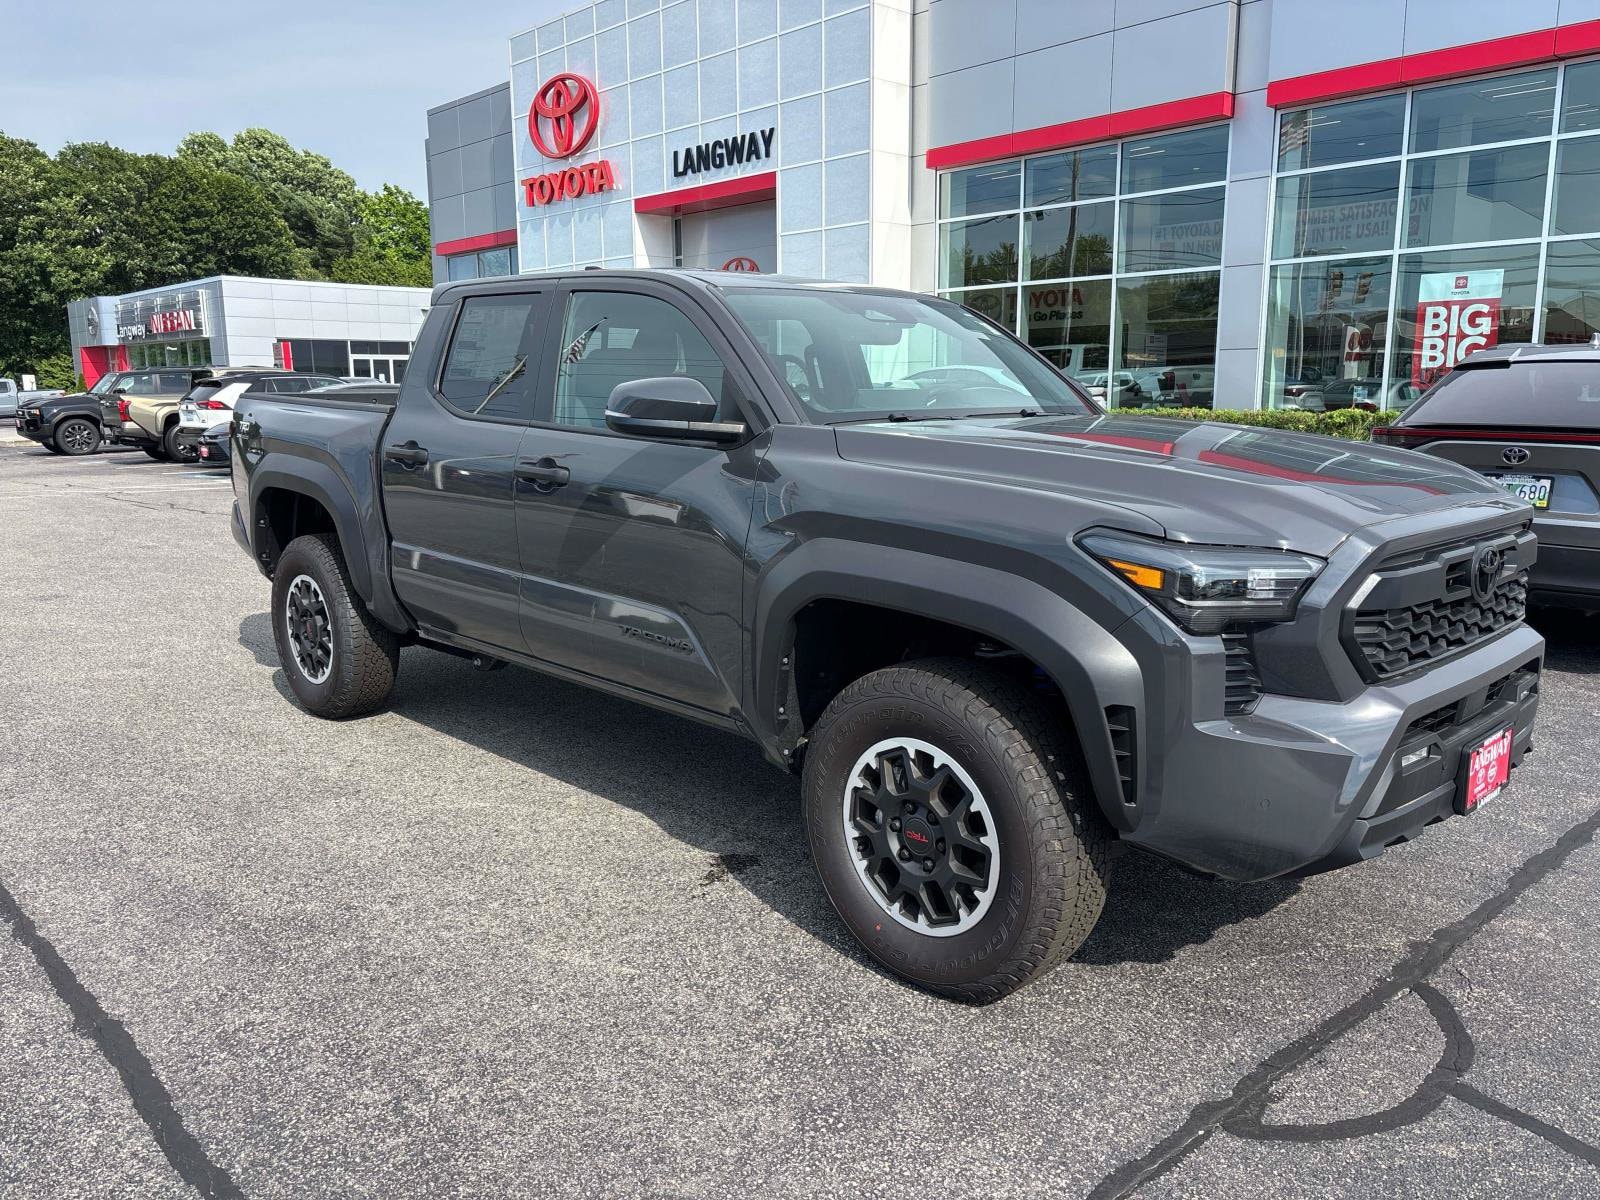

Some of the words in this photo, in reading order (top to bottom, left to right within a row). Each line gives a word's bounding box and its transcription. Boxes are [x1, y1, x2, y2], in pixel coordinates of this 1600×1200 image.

[673, 127, 775, 178] LANGWAY
[521, 160, 616, 207] TOYOTA
[1170, 222, 1210, 240] TOYOTA
[1311, 228, 1325, 243] IN
[1329, 224, 1352, 241] THE
[1355, 220, 1390, 240] USA!!
[1183, 241, 1195, 256] IN
[1006, 288, 1084, 311] TYOTA
[116, 323, 147, 340] Langway
[150, 309, 196, 333] NISSAN
[1033, 310, 1048, 322] Go
[1423, 303, 1492, 338] BIG
[1518, 484, 1547, 501] 680
[618, 625, 696, 655] TACOMA
[1470, 736, 1509, 777] LANGWAY
[906, 830, 929, 843] TRD
